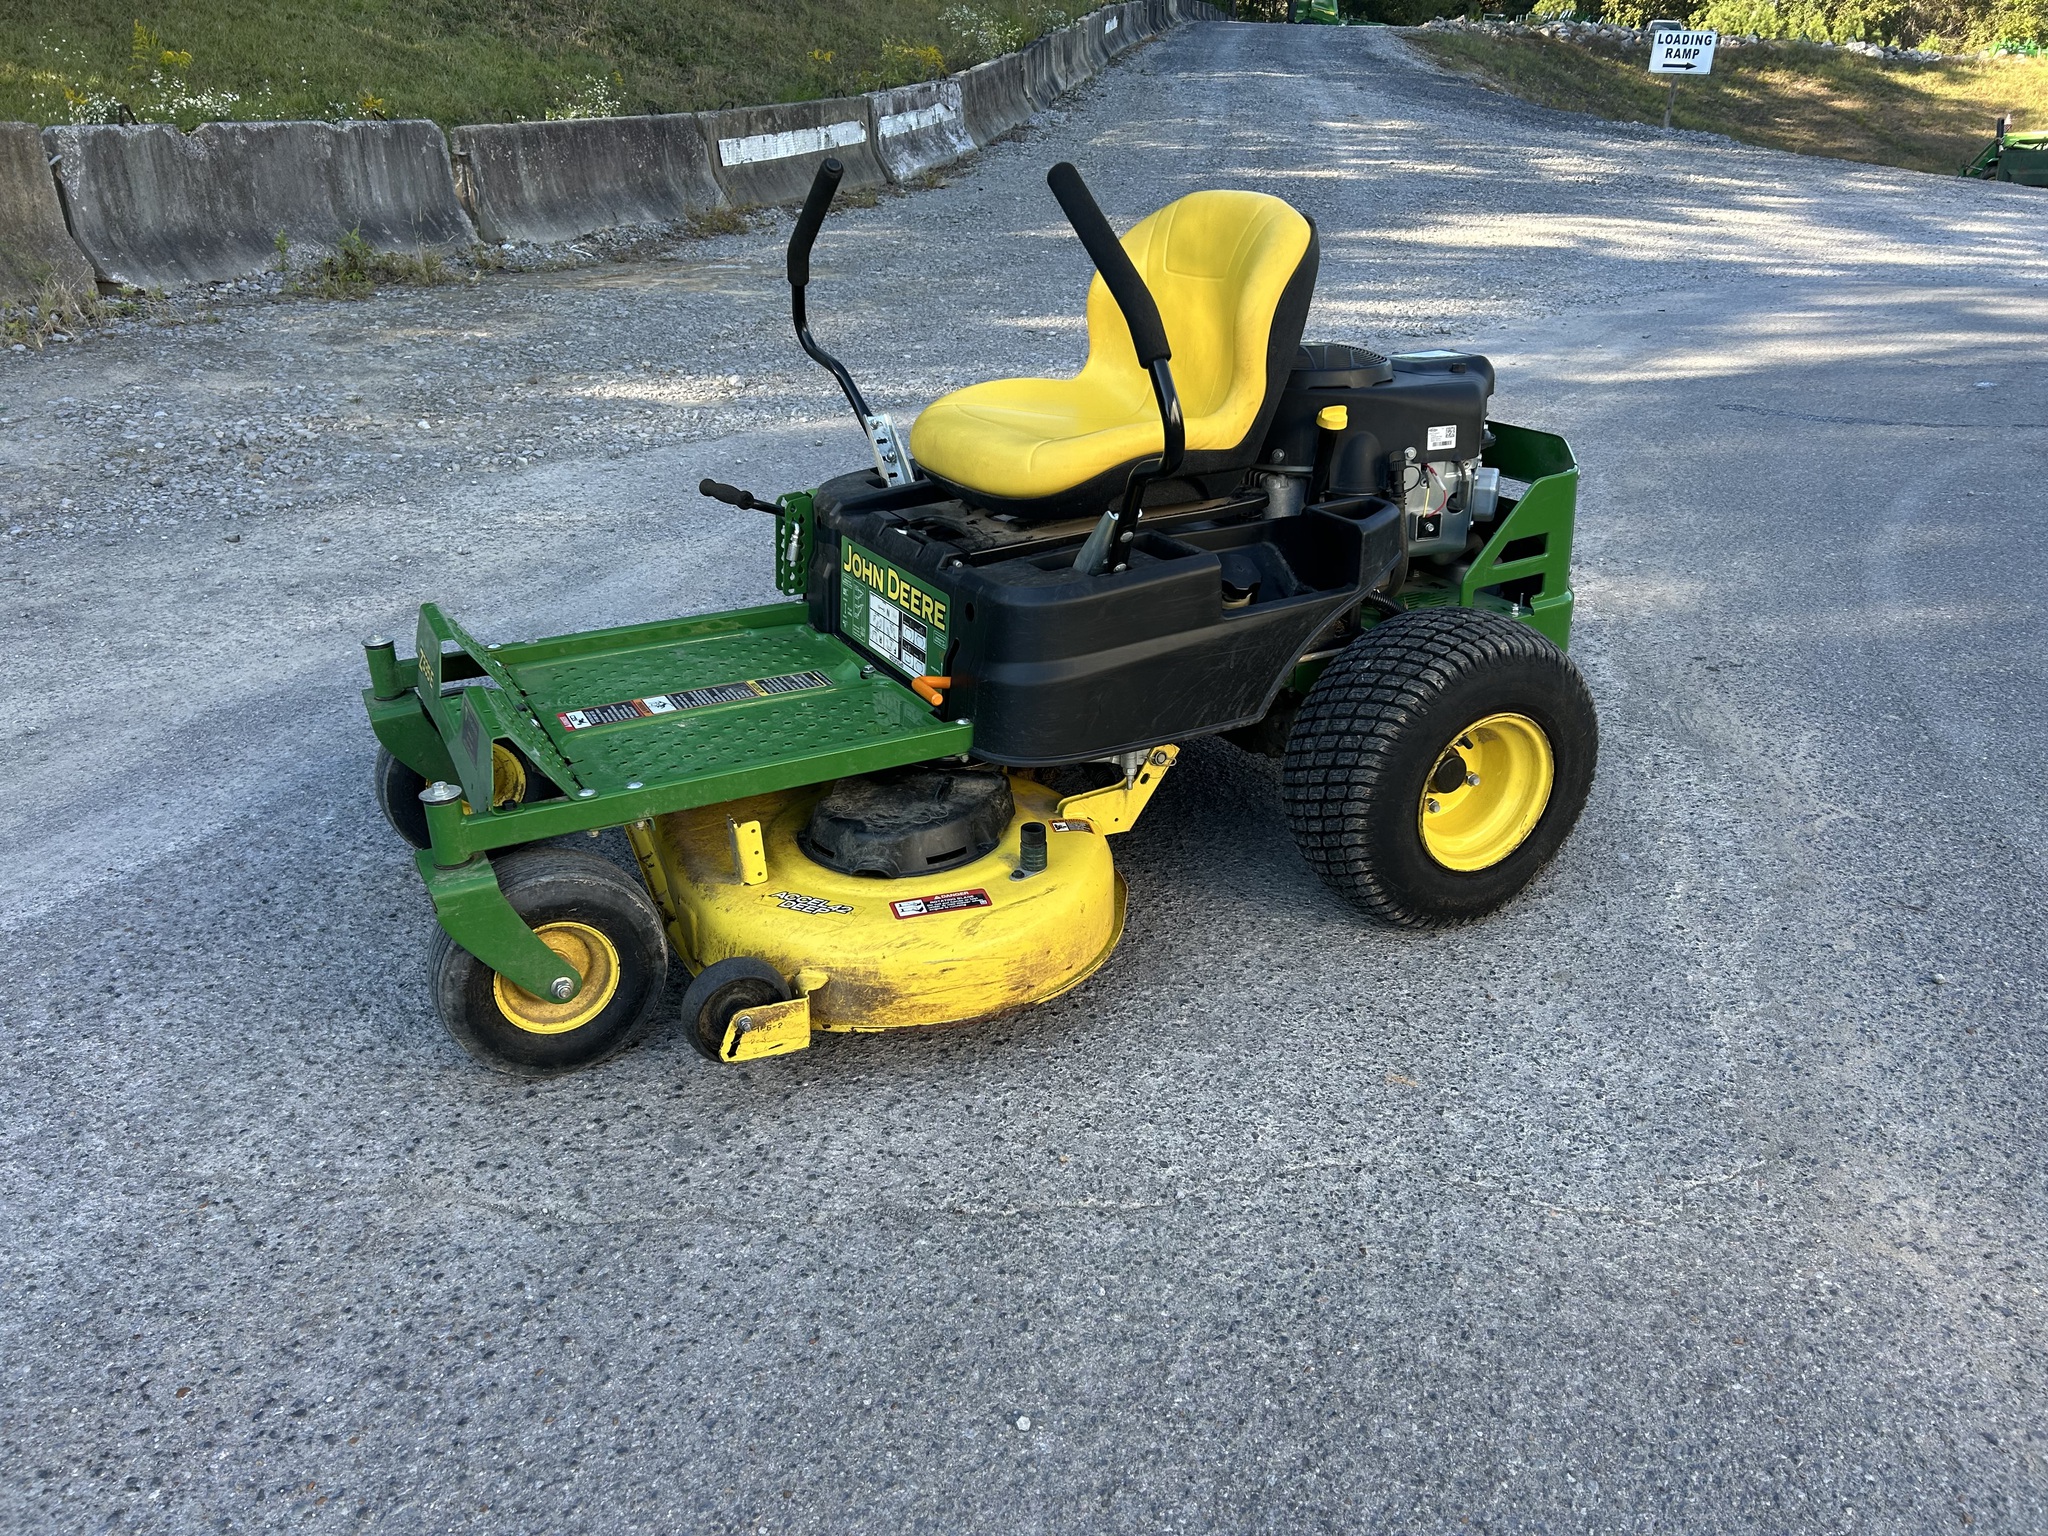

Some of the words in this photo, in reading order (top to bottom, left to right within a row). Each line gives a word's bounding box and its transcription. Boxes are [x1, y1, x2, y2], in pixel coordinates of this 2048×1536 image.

[1657, 33, 1713, 46] LOADING
[1665, 47, 1700, 60] RAMP
[843, 544, 884, 593] JOHN
[887, 567, 946, 631] DEERE
[940, 891, 970, 899] DANGER
[769, 891, 830, 908] ACCEL
[827, 904, 854, 914] 42
[777, 900, 831, 914] DEEP
